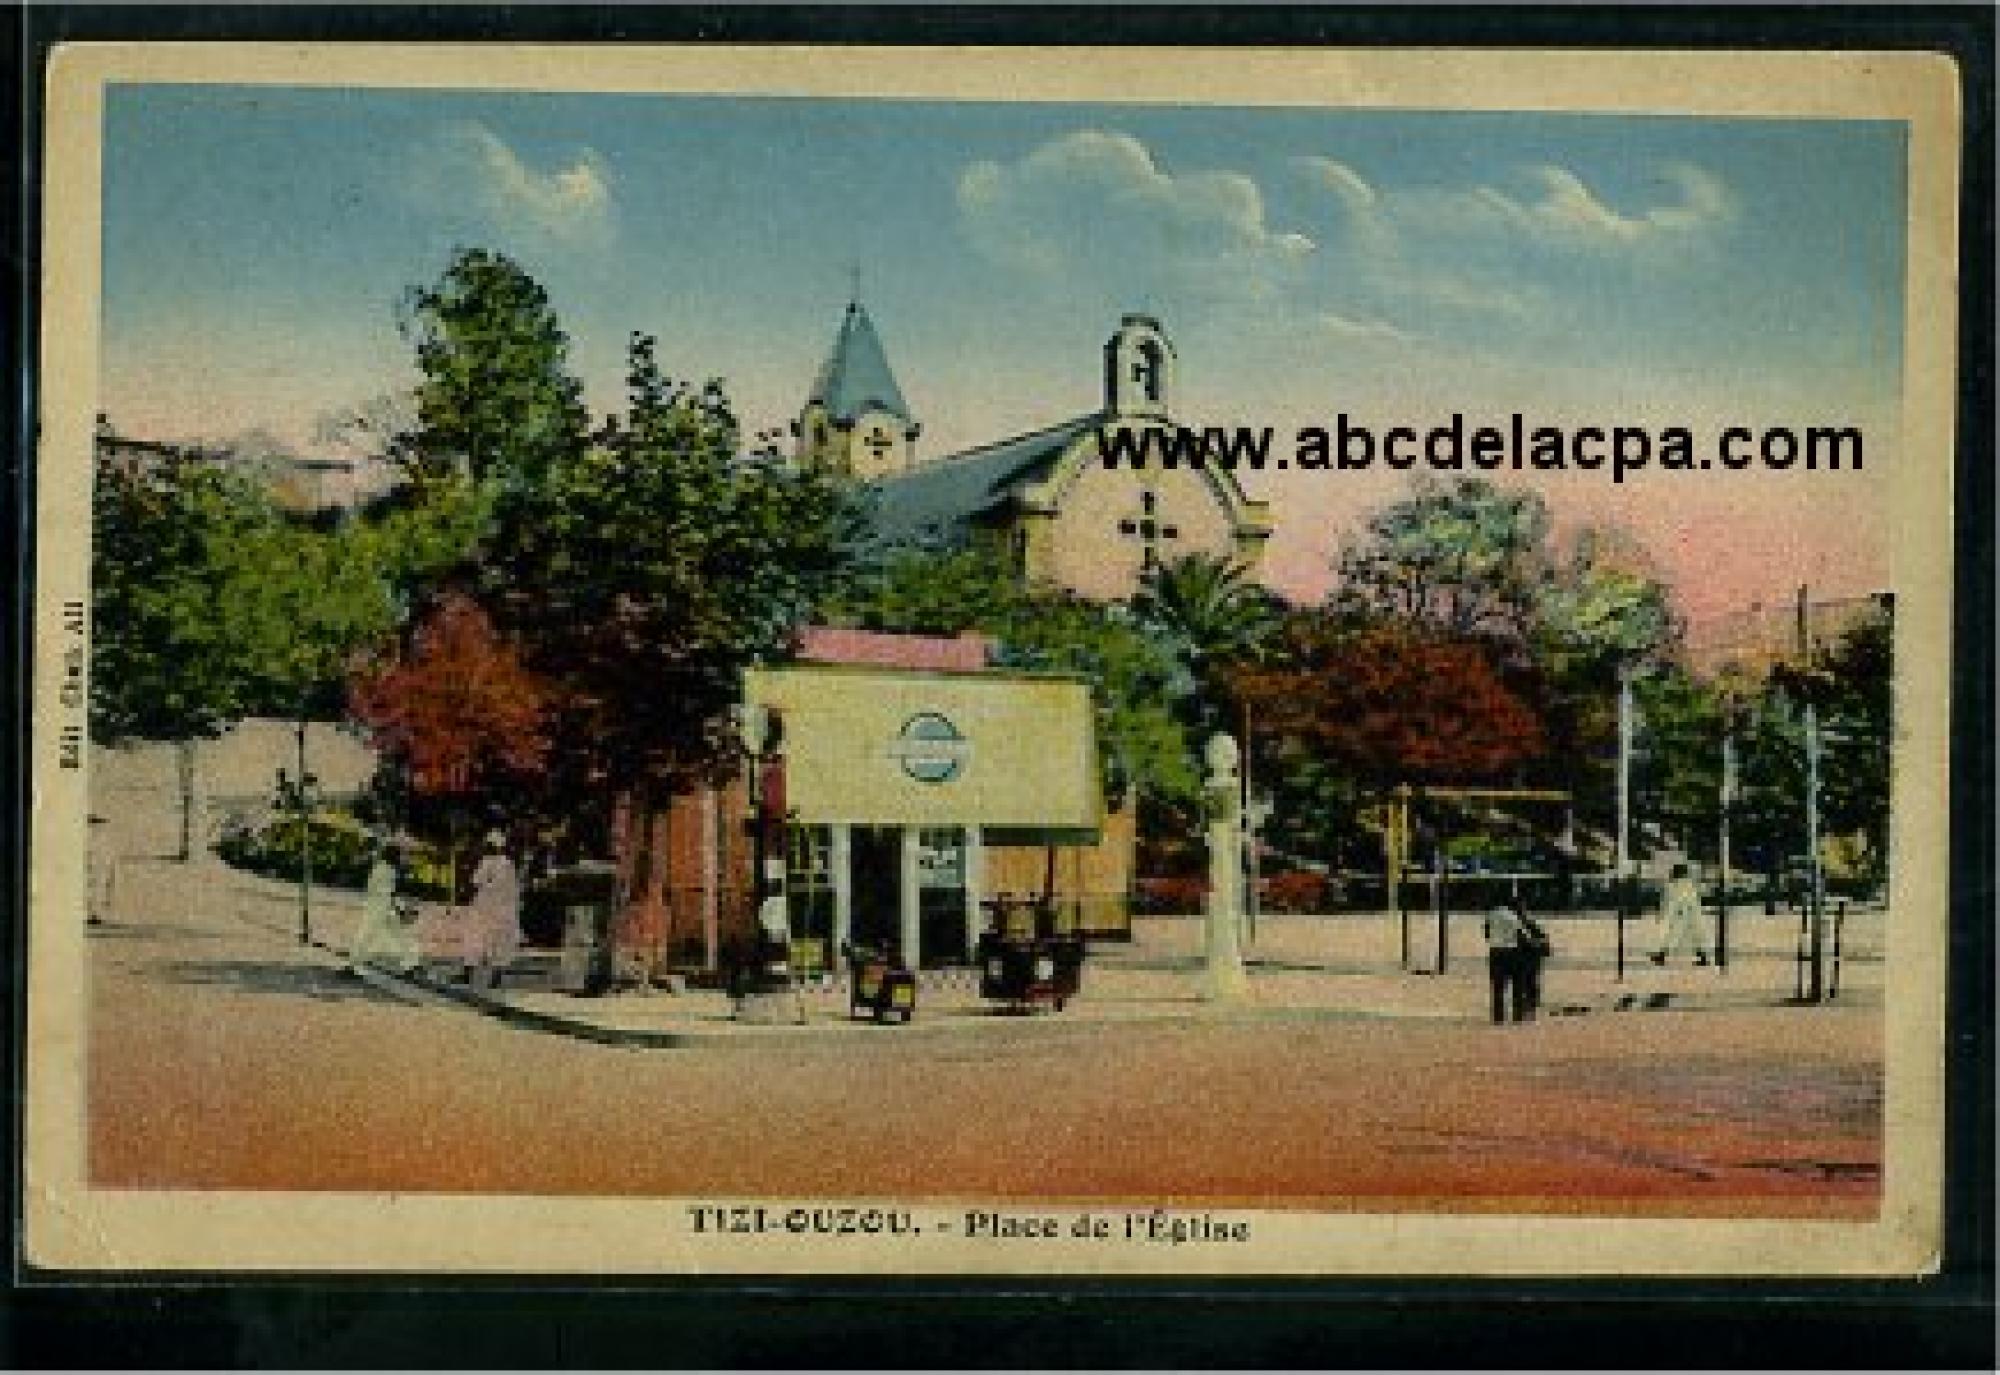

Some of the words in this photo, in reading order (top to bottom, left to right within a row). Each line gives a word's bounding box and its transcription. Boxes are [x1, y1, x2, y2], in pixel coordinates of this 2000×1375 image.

[686, 1207, 921, 1238] TIZI-OUZOU.
[964, 1210, 1059, 1239] Place
[1070, 1212, 1110, 1240] de
